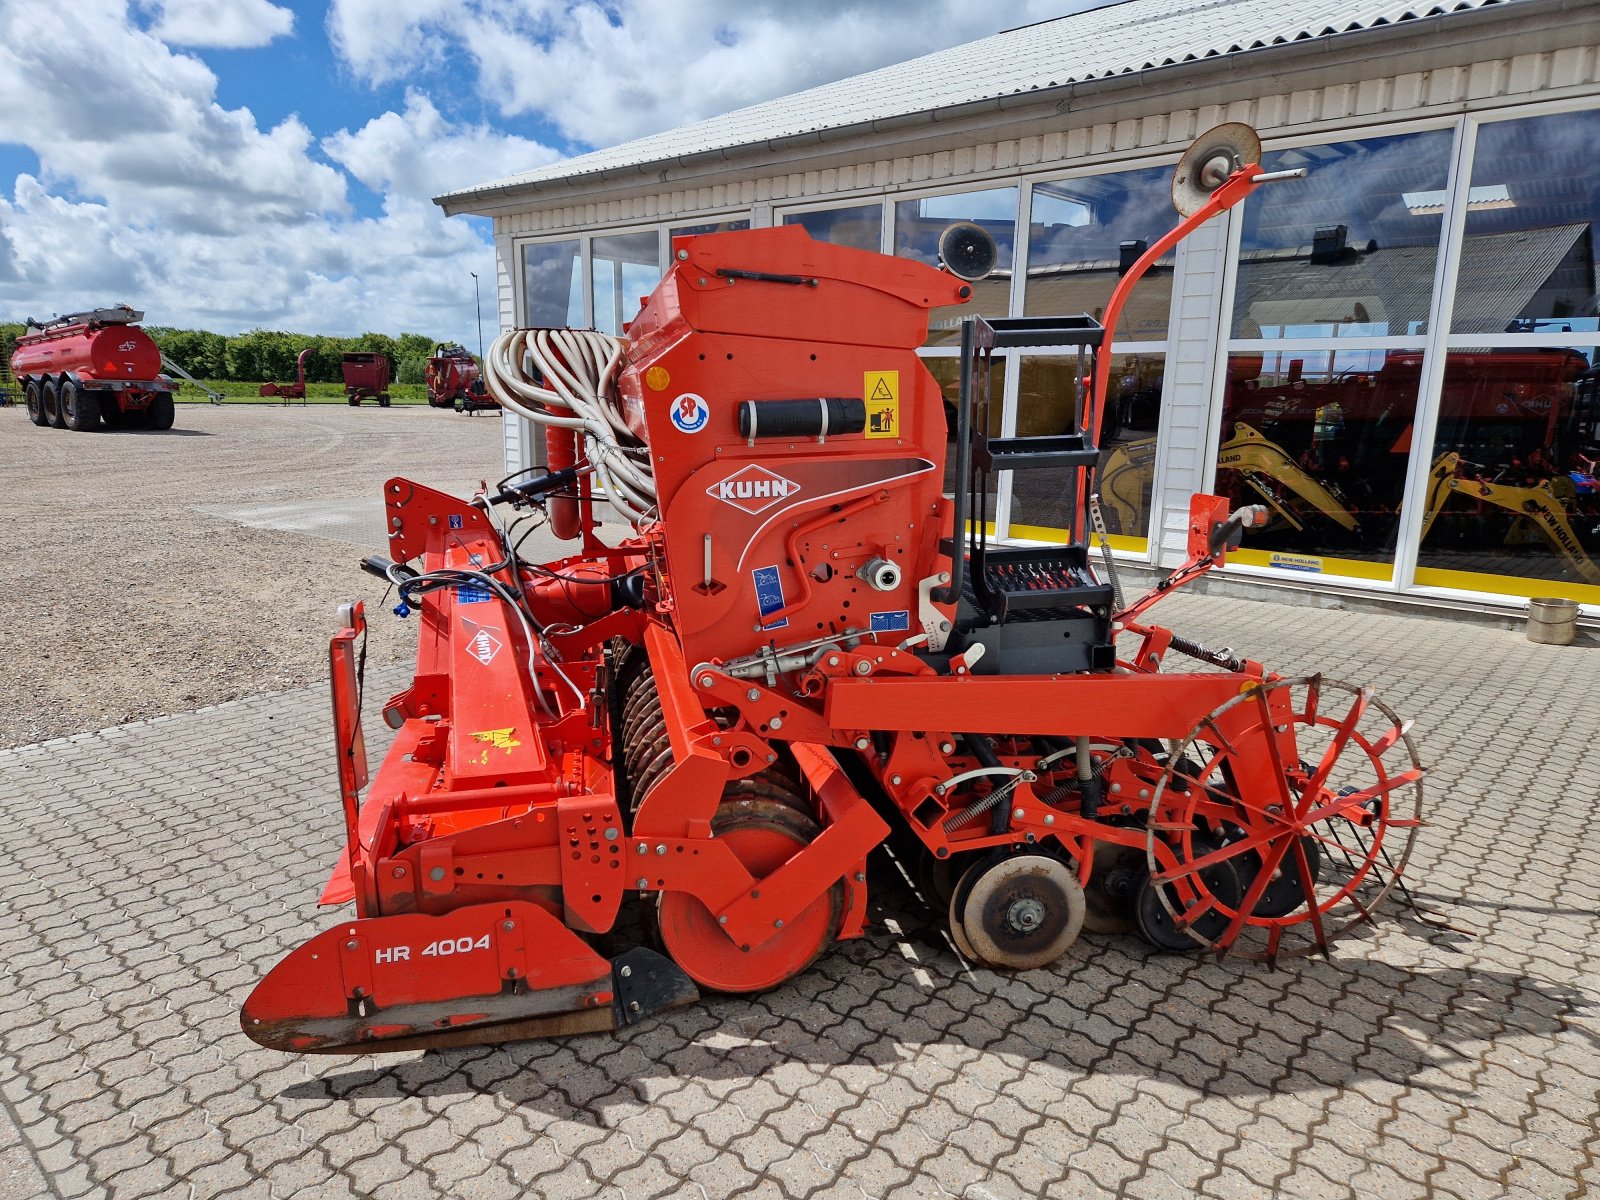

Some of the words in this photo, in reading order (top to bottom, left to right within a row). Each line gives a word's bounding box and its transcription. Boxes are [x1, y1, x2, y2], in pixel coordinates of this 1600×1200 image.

[719, 479, 789, 499] KUHN
[1541, 505, 1558, 527] NEW
[1553, 526, 1584, 564] HOLLAND
[476, 634, 493, 661] KUHN
[375, 945, 410, 964] HR
[421, 934, 491, 957] 4004
